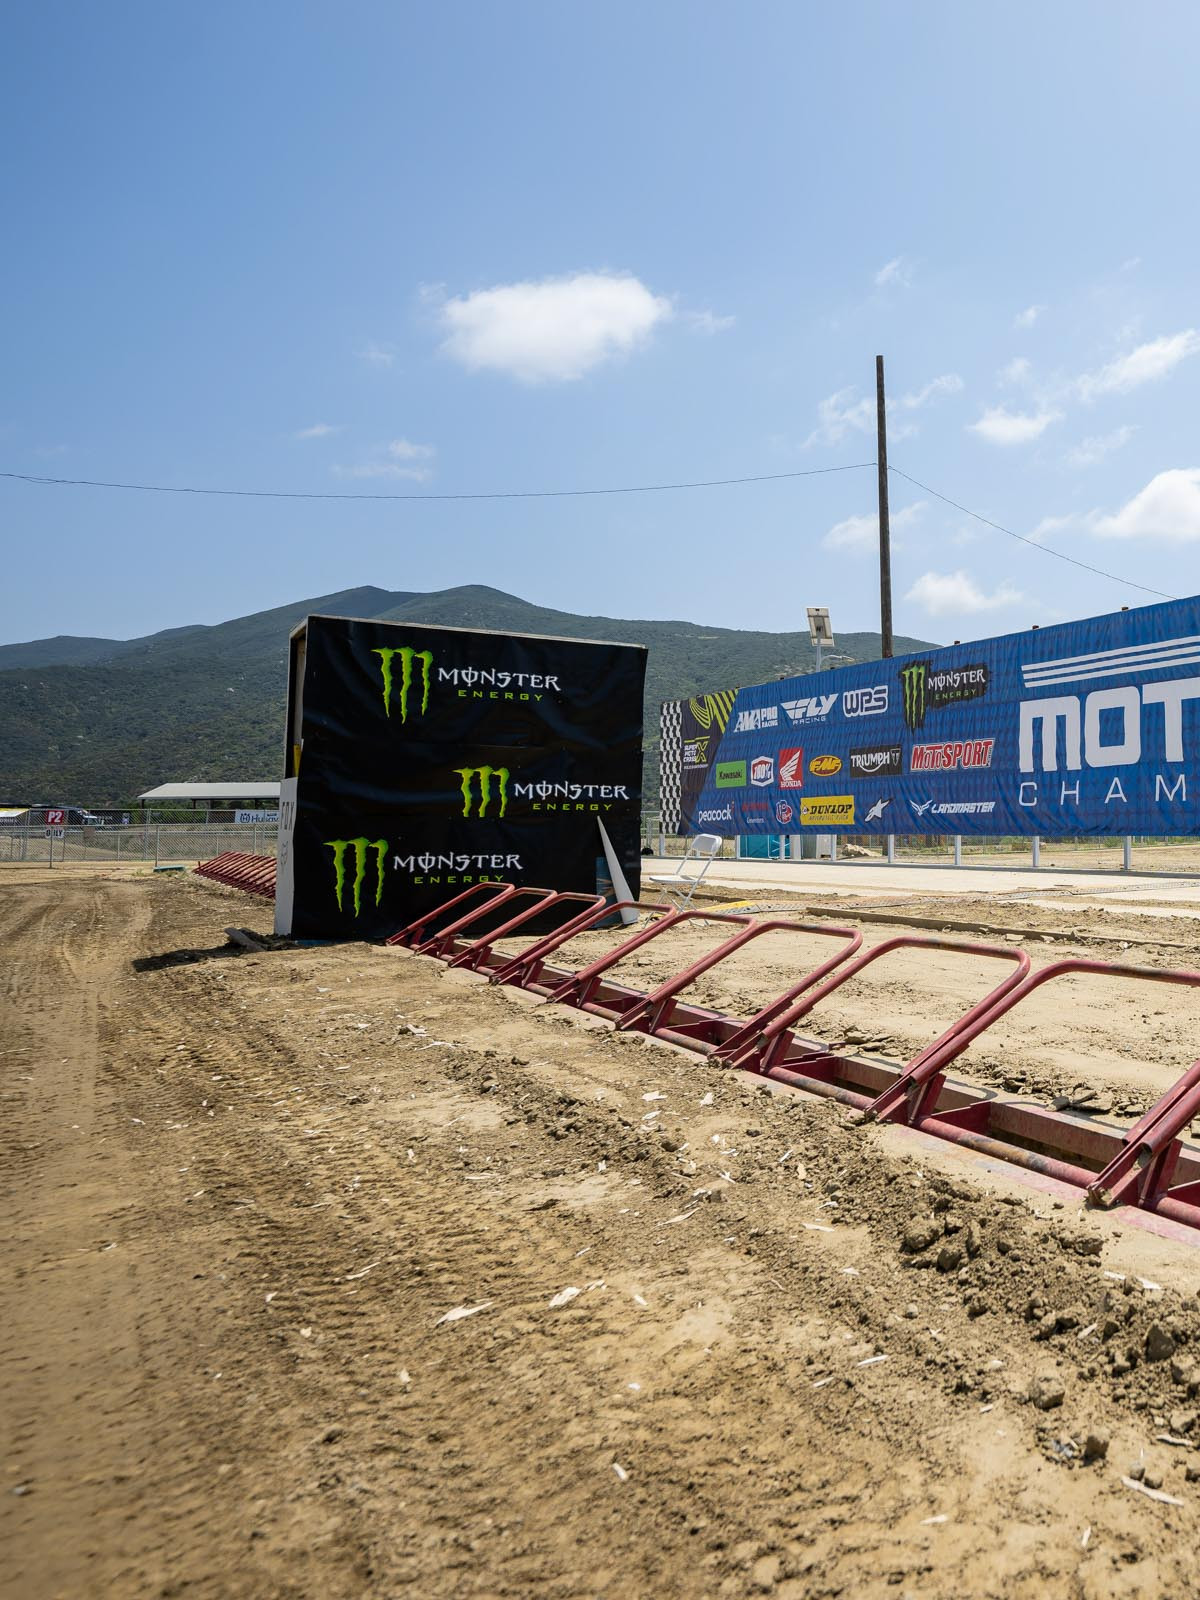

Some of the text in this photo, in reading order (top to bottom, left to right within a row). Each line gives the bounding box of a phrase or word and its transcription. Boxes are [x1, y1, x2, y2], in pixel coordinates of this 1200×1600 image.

[438, 666, 561, 692] MONSTER
[928, 668, 986, 691] MONSTER
[458, 689, 543, 701] ENERGY
[843, 685, 888, 717] WPS
[935, 688, 977, 700] ENERGY
[761, 706, 778, 720] PRO
[785, 693, 839, 719] FLY
[793, 715, 827, 725] RACING
[809, 757, 842, 772] FMF
[851, 751, 890, 770] TRIUMPH
[753, 763, 771, 780] 100%
[514, 780, 630, 800] MONSTER
[780, 780, 802, 788] HONDA
[533, 803, 613, 811] ENERGY
[698, 804, 732, 824] peacock
[810, 804, 852, 815] DUNLOP
[931, 801, 996, 814] LANDMASTER
[48, 811, 62, 823] P2
[393, 851, 523, 872] MONSTER
[414, 874, 504, 884] ENERGY
